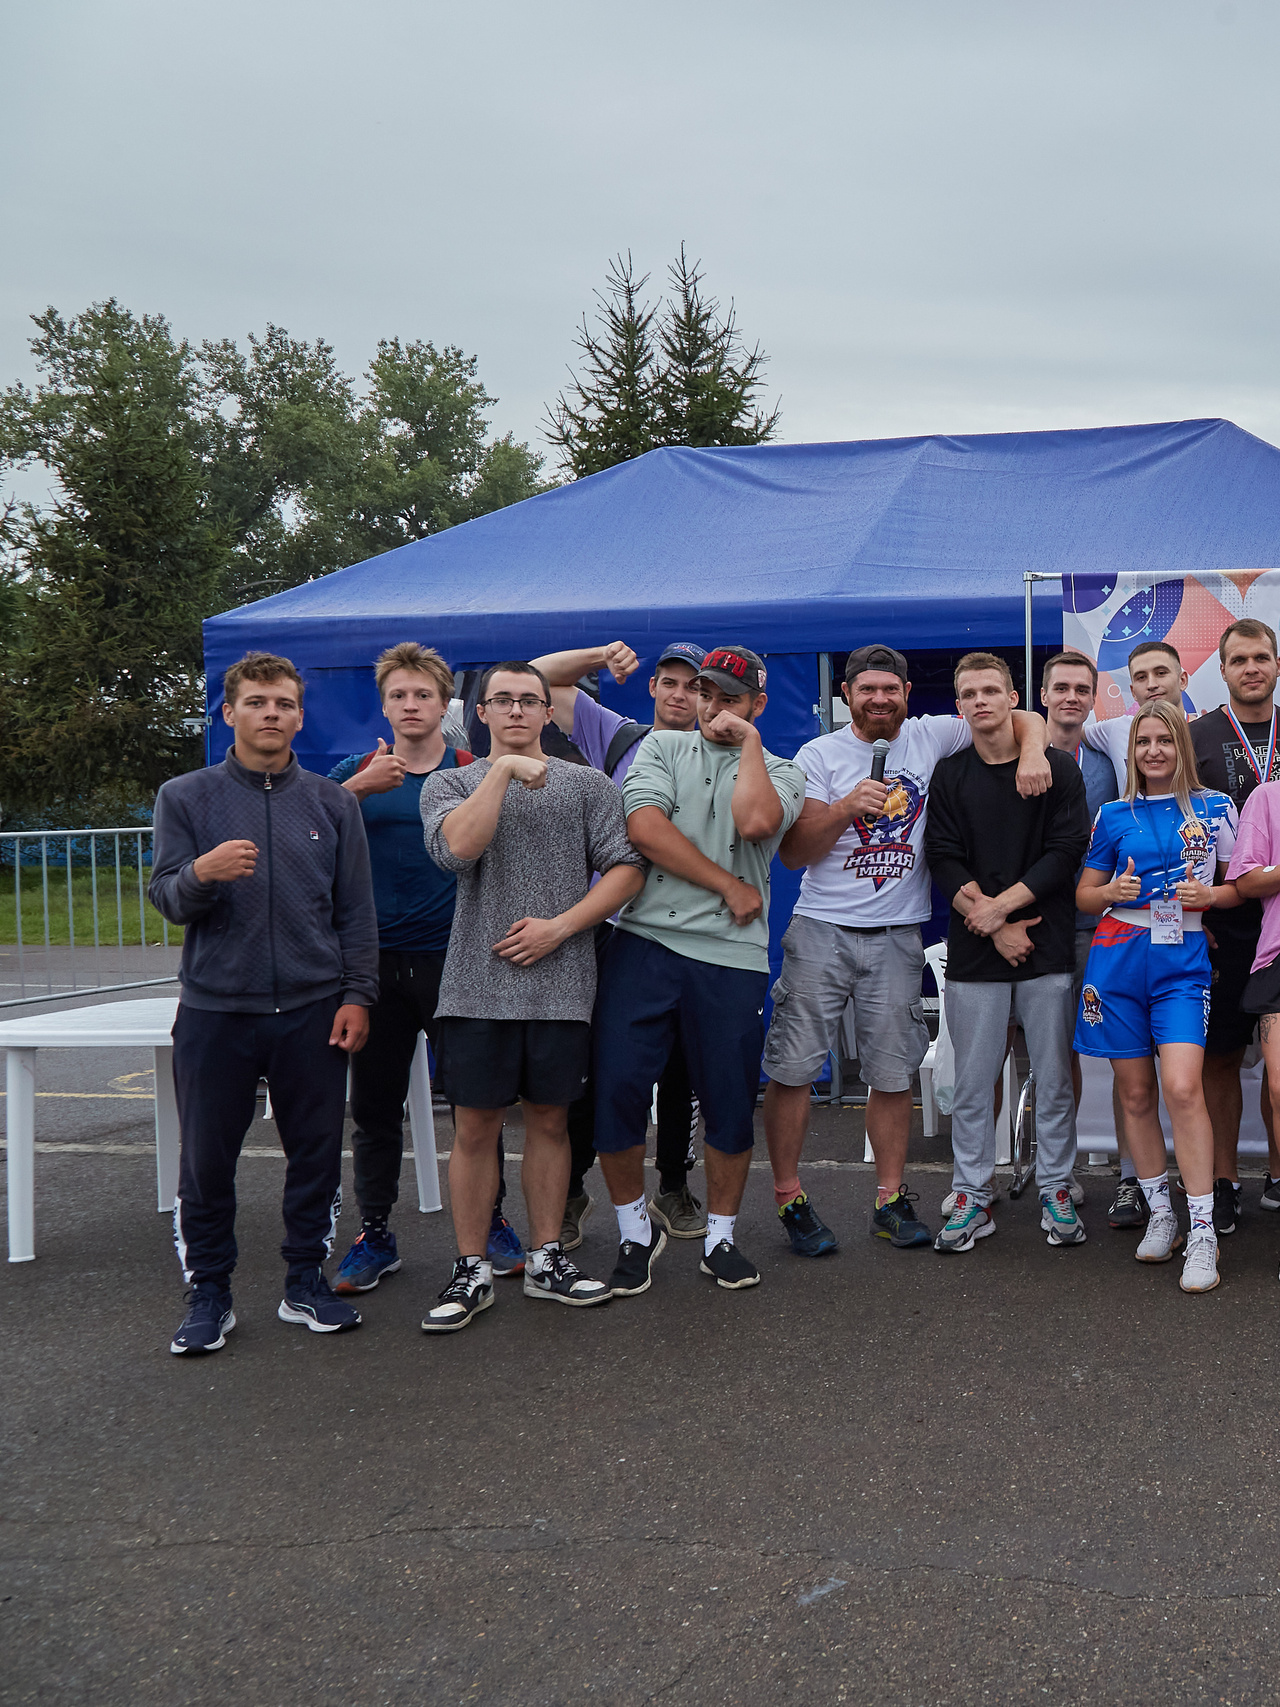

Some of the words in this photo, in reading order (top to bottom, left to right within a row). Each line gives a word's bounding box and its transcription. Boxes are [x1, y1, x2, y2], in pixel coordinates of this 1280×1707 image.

[1222, 743, 1239, 799] ARMOUR
[846, 851, 915, 869] НАЦИЯ
[858, 866, 901, 877] МИРА
